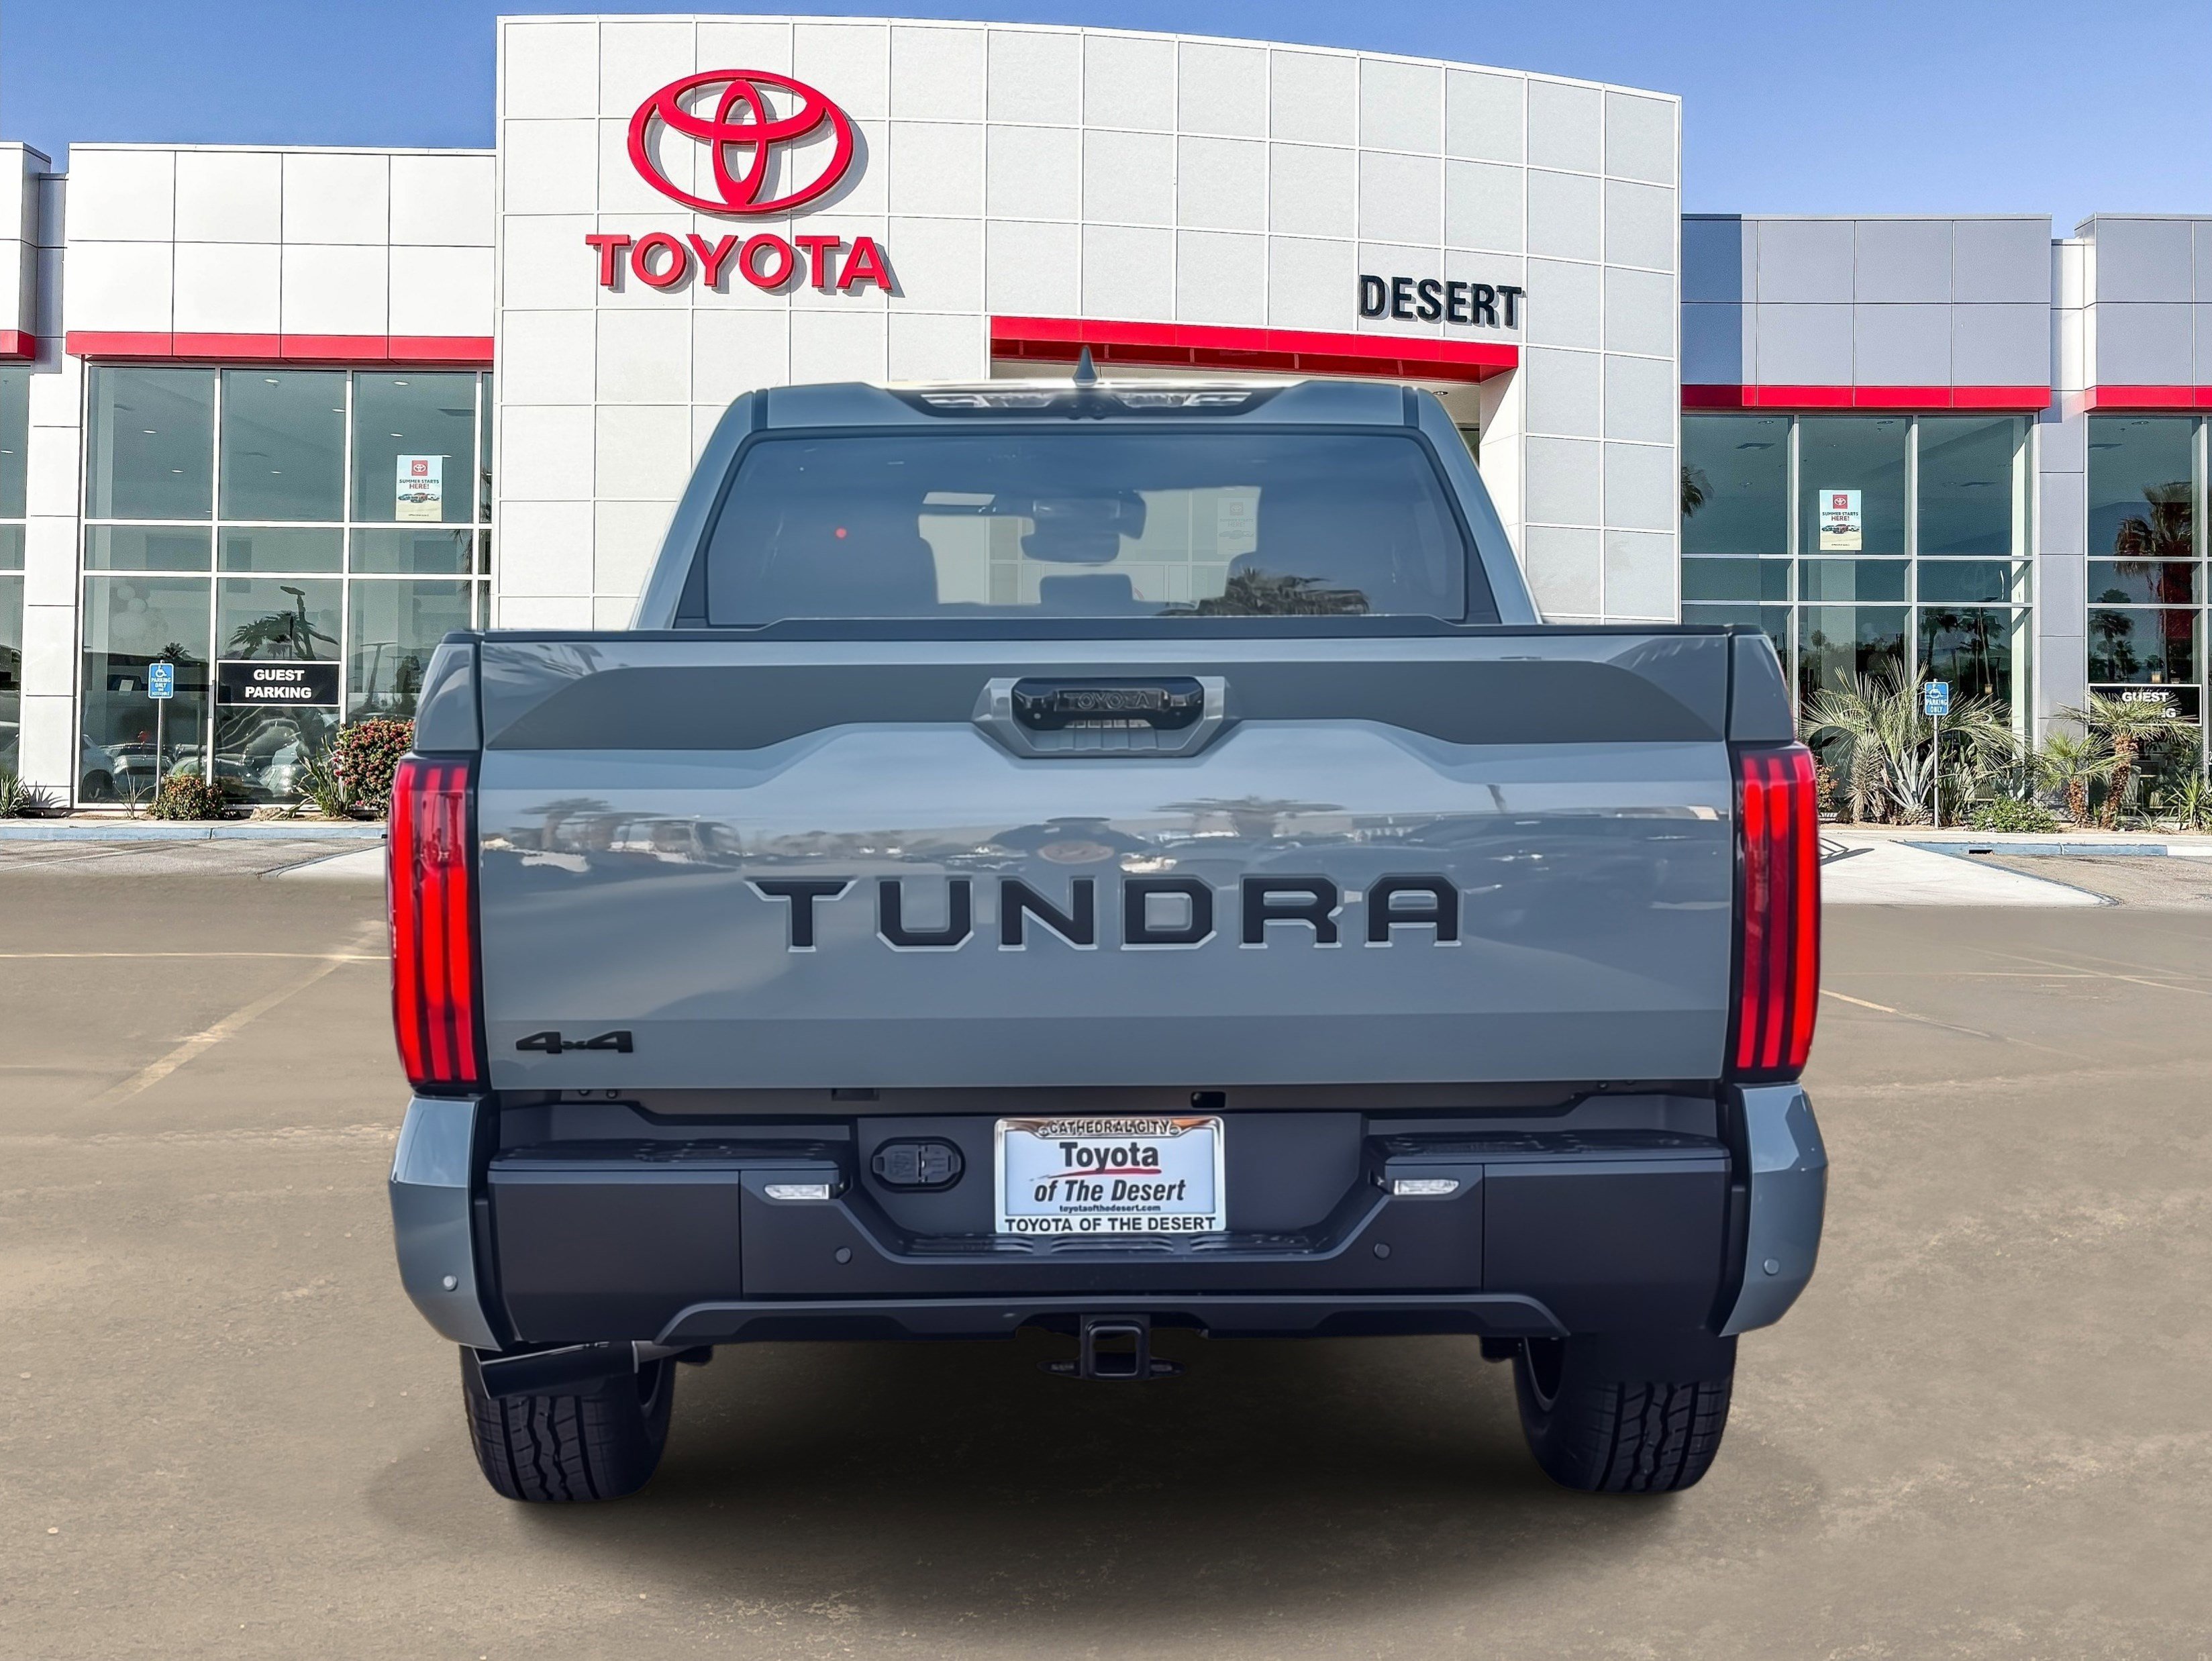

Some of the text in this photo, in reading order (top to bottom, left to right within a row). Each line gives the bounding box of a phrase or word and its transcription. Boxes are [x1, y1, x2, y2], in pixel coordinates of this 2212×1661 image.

[586, 232, 892, 290] TOYOTA
[1359, 274, 1522, 326] DESERT
[254, 669, 305, 681] GUEST
[245, 686, 311, 699] PARKING
[2121, 691, 2169, 702] GUEST
[745, 874, 1462, 952] TUNDRA
[1050, 1120, 1170, 1134] CATHEDRAL CITY
[1059, 1142, 1159, 1174] Toyota
[1034, 1180, 1186, 1202] of The Desert
[1059, 1204, 1161, 1213] toyotaofthedesert.com
[1005, 1217, 1216, 1231] TOYOTA OF THE DESERT
